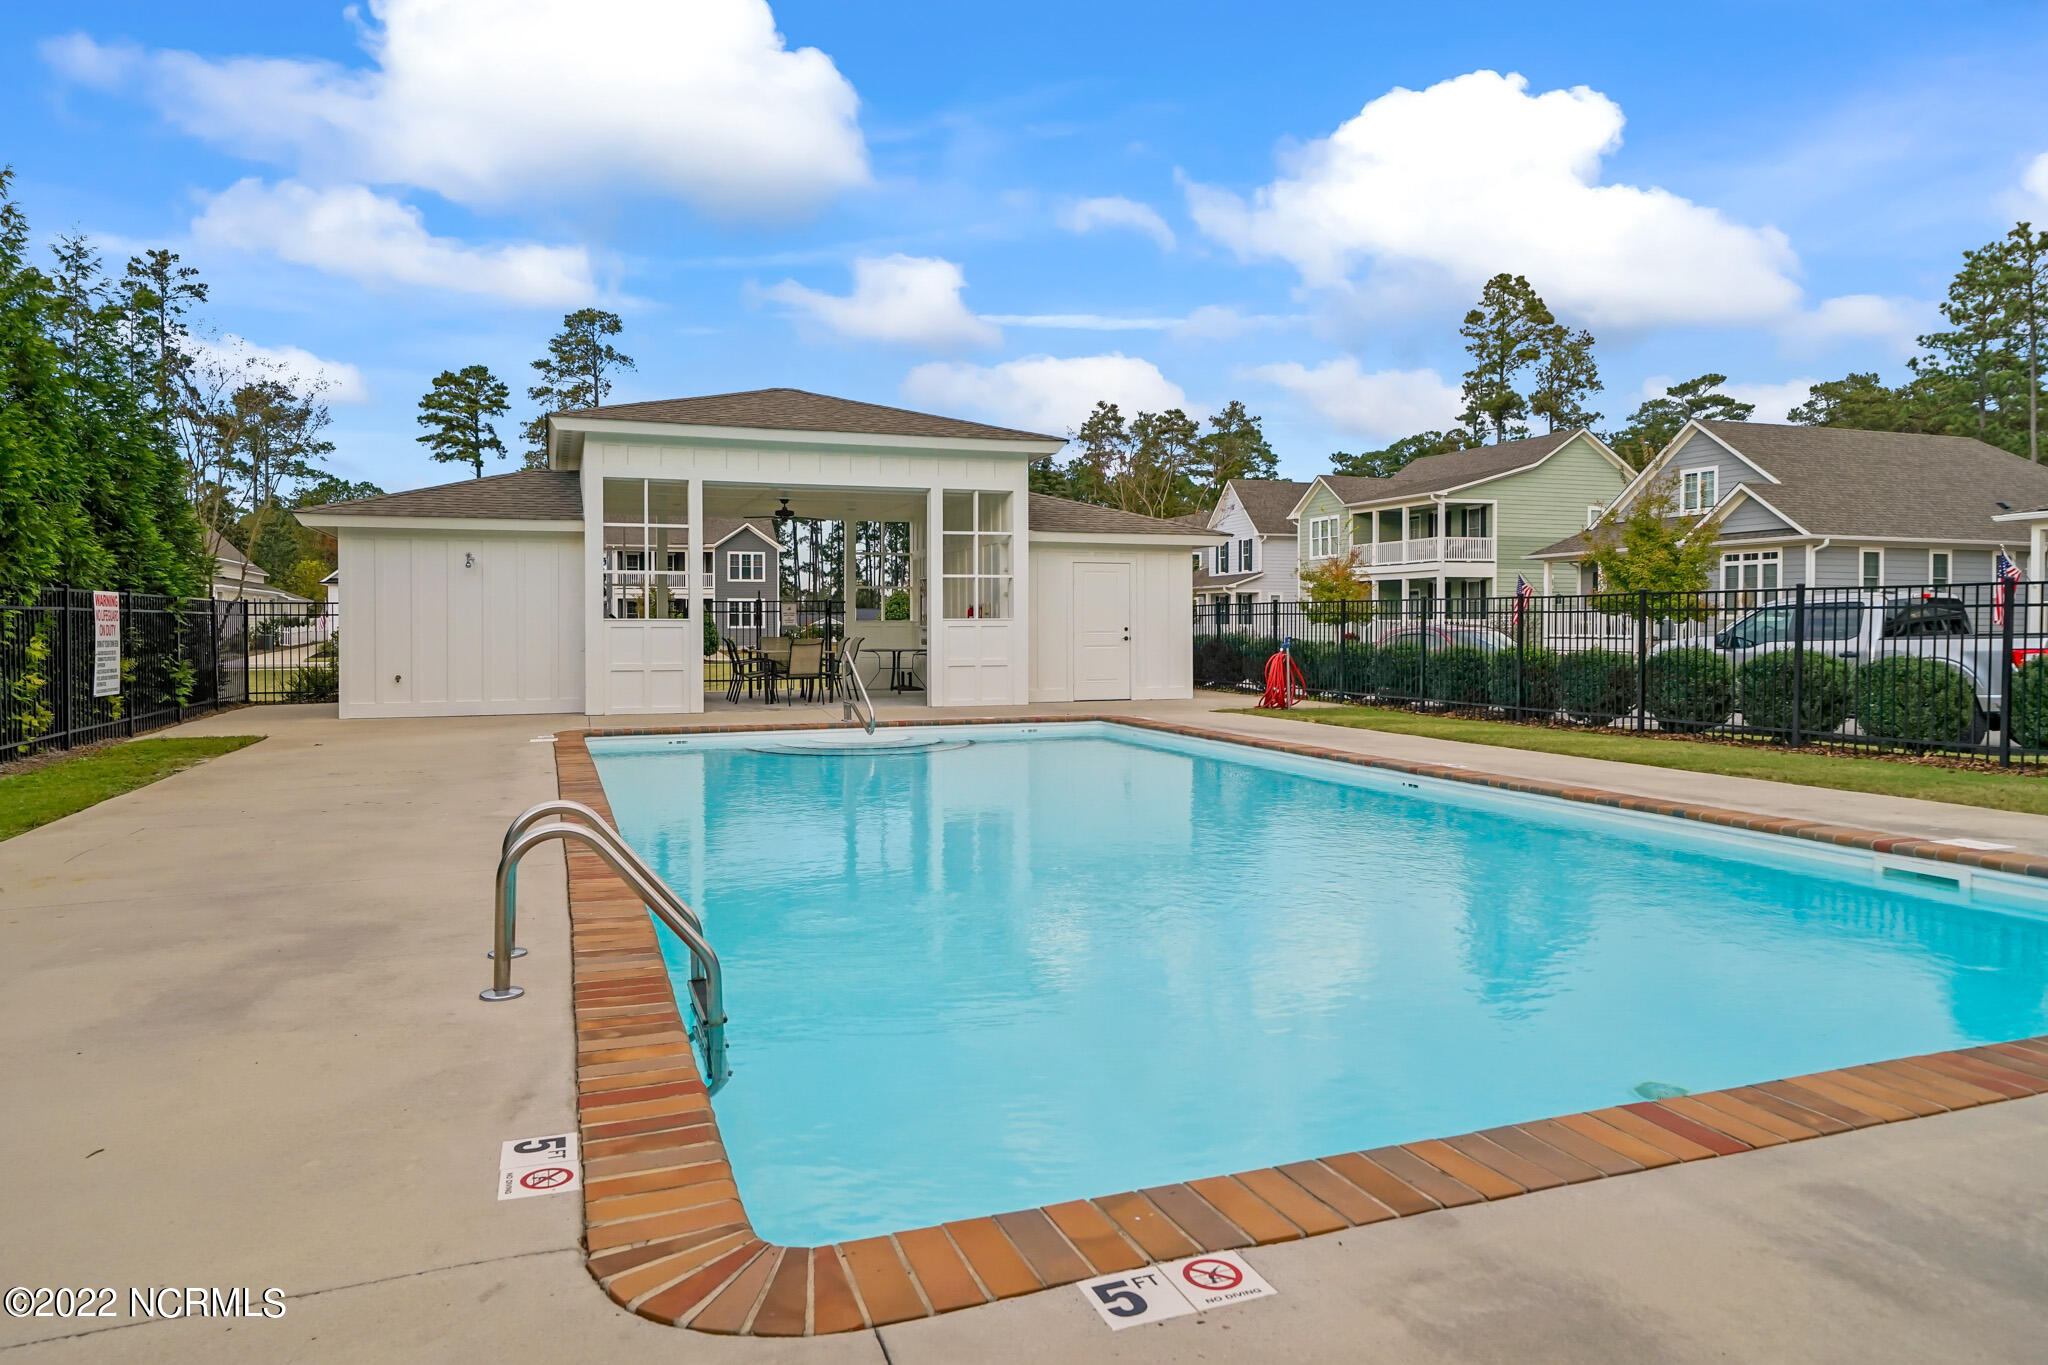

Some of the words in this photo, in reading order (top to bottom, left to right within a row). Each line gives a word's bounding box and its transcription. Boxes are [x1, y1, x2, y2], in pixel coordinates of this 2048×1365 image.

[95, 594, 118, 607] WARNING
[106, 625, 116, 636] DUTY
[514, 1136, 566, 1153] 5
[547, 1149, 566, 1159] FT
[1091, 1280, 1148, 1317] 5
[1131, 1274, 1159, 1290] FT
[1205, 1296, 1223, 1304] NO
[1225, 1288, 1262, 1300] DIVING
